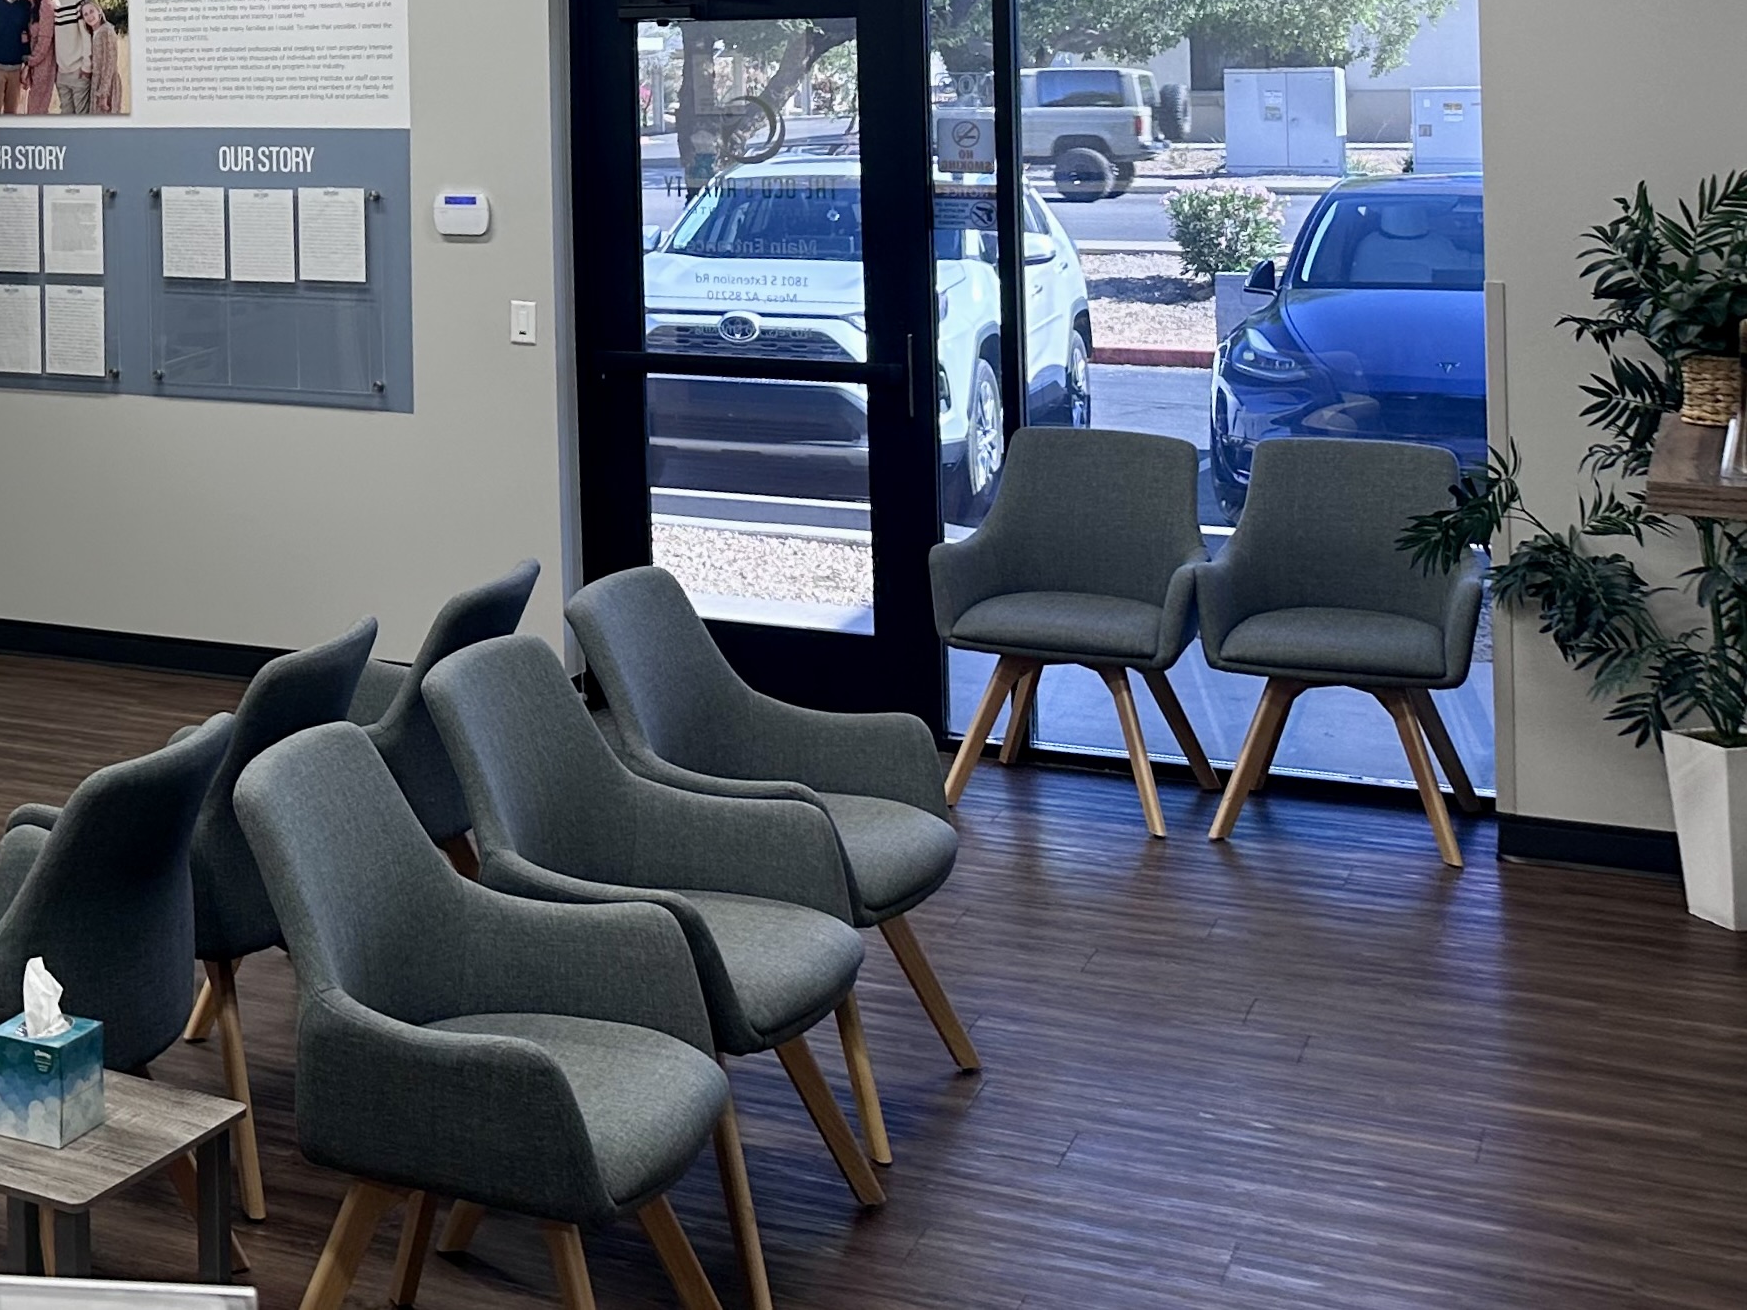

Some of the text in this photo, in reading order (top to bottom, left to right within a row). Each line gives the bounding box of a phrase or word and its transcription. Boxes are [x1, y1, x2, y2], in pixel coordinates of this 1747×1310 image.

[15, 145, 67, 171] STORY
[218, 146, 314, 173] OUR STORY
